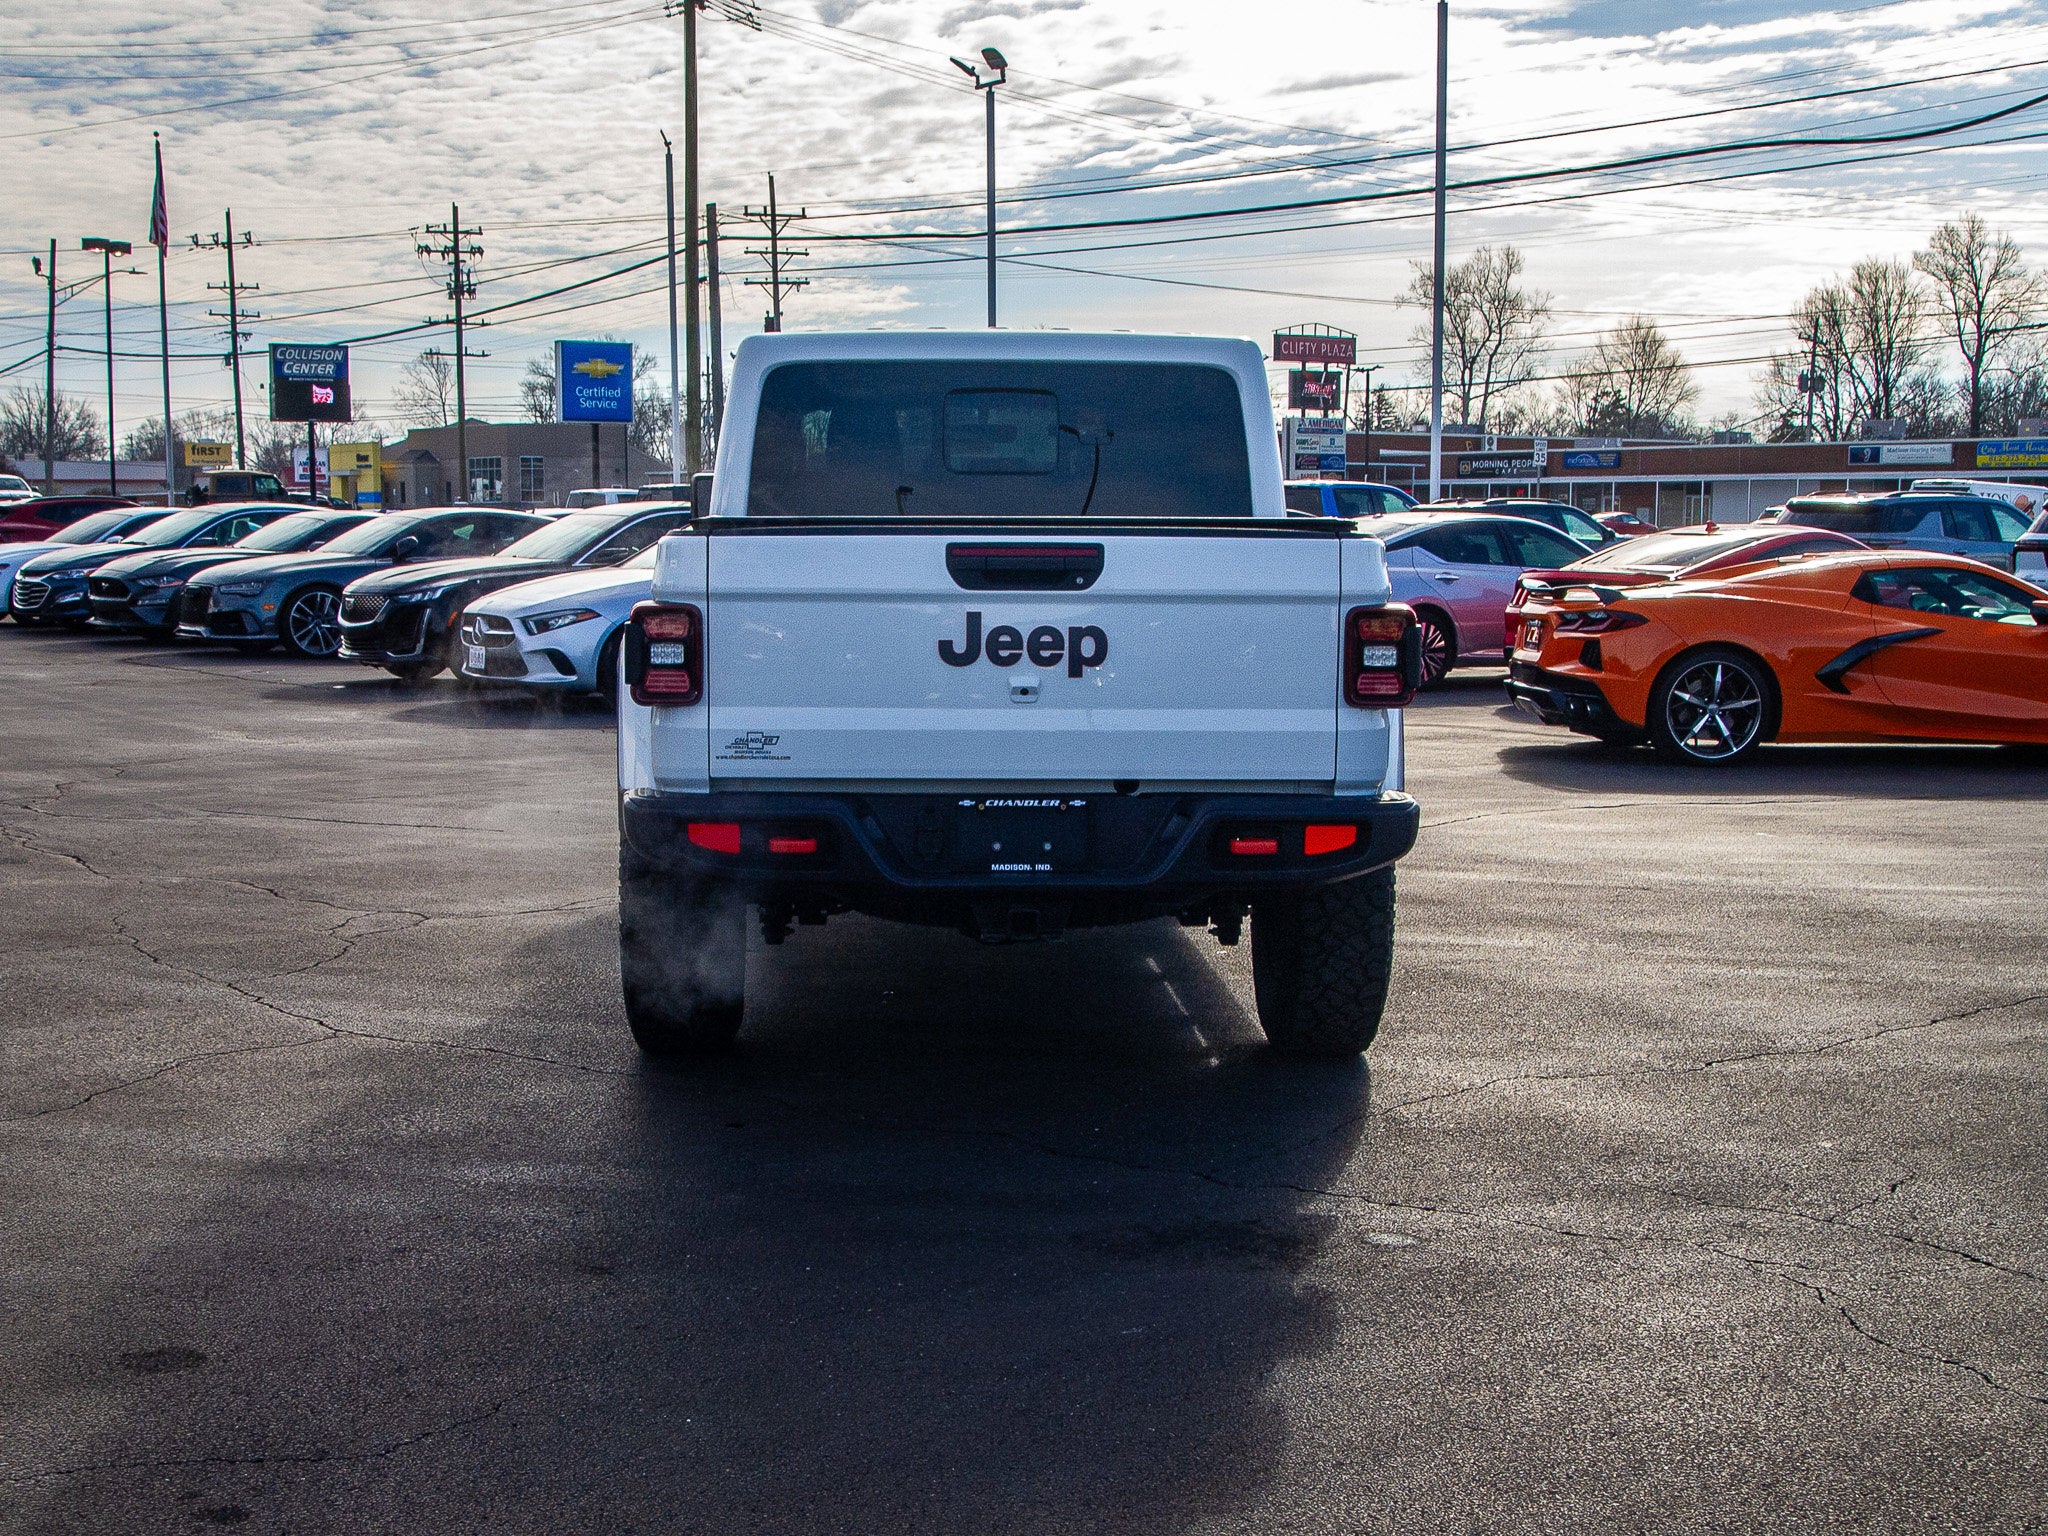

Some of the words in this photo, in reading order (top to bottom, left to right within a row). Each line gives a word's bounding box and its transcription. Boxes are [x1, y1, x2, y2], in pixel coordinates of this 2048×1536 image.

[276, 347, 344, 361] COLLISION
[1281, 341, 1317, 355] CLIFTY
[1321, 343, 1354, 358] PLAZA
[283, 361, 335, 375] CENTER
[575, 386, 621, 398] Certified
[579, 397, 618, 409] Service
[1535, 452, 1546, 463] 35
[1472, 460, 1509, 469] MORNING
[1511, 459, 1537, 468] PEOPL
[938, 611, 1109, 678] Jeep
[985, 799, 1060, 807] CHANDLER
[1035, 863, 1053, 871] IND.
